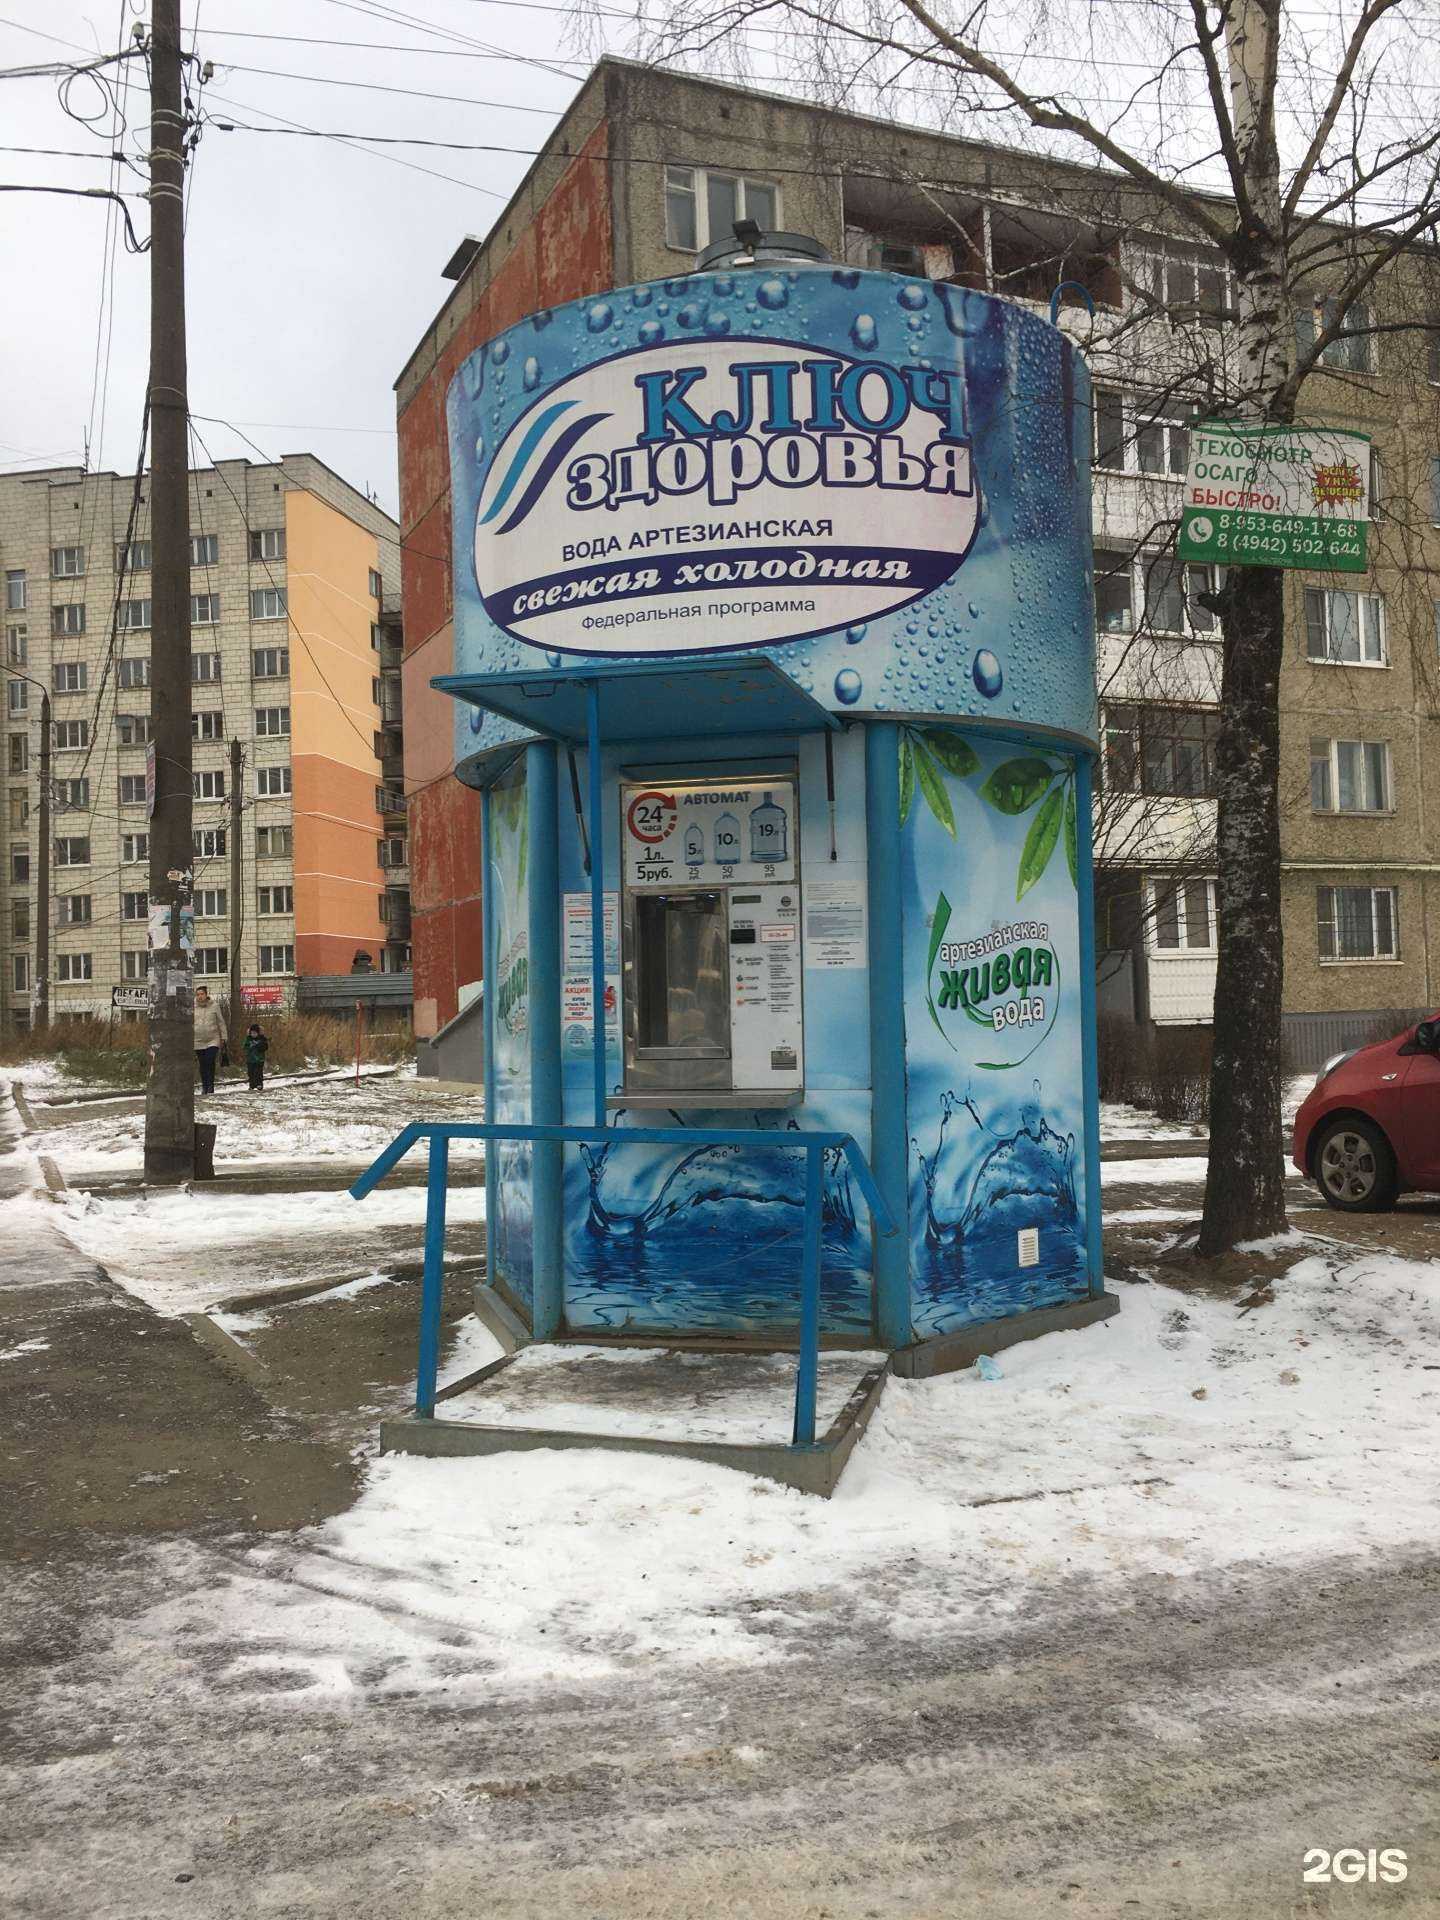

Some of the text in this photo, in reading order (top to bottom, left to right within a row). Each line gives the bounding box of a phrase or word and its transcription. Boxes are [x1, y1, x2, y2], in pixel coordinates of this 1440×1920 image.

[635, 360, 971, 441] КЛЮЧ
[1196, 439, 1312, 464] ТЕХОСМОТР
[566, 431, 974, 508] здоровья
[1195, 463, 1258, 483] ОСАГО
[1193, 488, 1280, 511] БЫСТРО!
[562, 518, 833, 562] ВОДА АРТЕЗИАНСКАЯ
[1217, 533, 1228, 548] 8
[1233, 534, 1287, 555] (4942)
[512, 549, 912, 615] свежая холодная
[581, 597, 816, 631] Федеральная программа
[683, 791, 751, 806] АВТОМАТ
[637, 805, 663, 824] 24
[641, 824, 662, 832] часа
[688, 867, 700, 875] 25
[722, 866, 733, 874] 50
[764, 864, 775, 872] 95
[940, 921, 1048, 968] артезианская
[992, 996, 1044, 1032] вода
